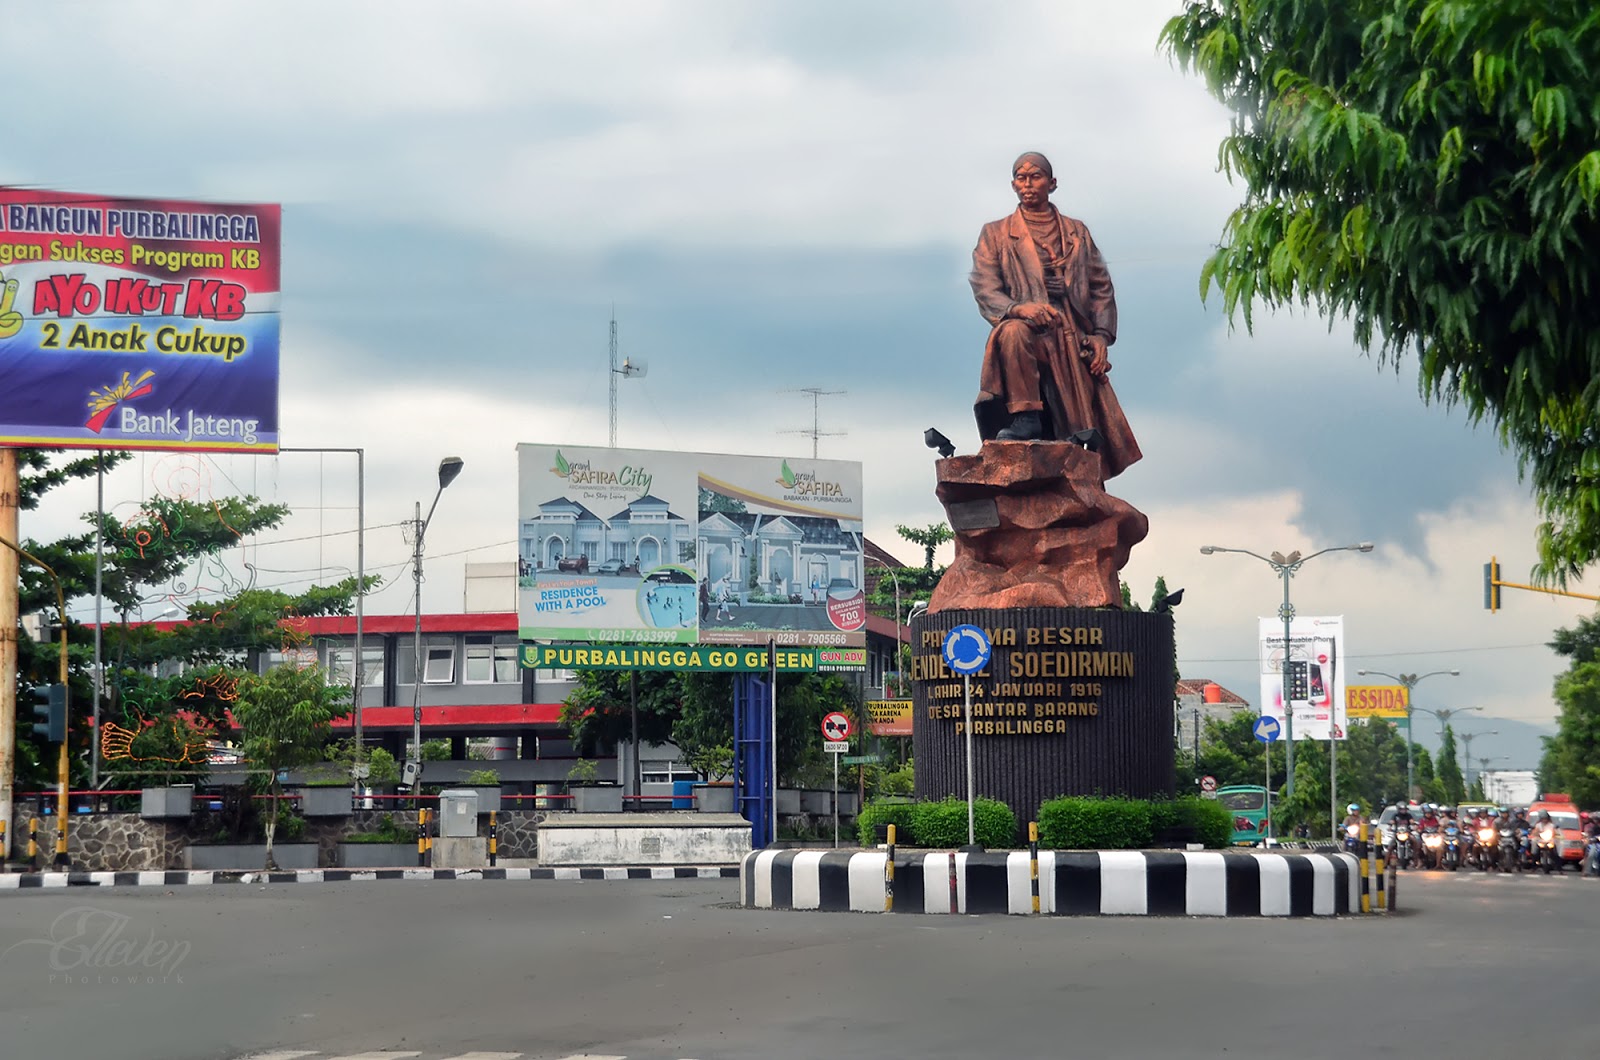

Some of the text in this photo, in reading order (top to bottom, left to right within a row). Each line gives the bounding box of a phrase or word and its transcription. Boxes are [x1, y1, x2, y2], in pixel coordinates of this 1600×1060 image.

[8, 204, 103, 236] BANGUN
[107, 211, 260, 242] PURBALINGGA
[50, 240, 124, 264] Sukses
[131, 244, 224, 271] Program
[231, 249, 260, 269] KB
[33, 273, 101, 317] AYO
[183, 279, 246, 320] KB
[41, 322, 246, 362] 2 Anak Cukup
[121, 407, 259, 444] Bank Jateng
[572, 465, 653, 498] SAFIRA City
[798, 481, 843, 496] SAFIRA
[540, 587, 598, 600] RESIDENCE
[535, 596, 607, 612] WITH A POOL
[840, 610, 858, 622] 700
[599, 630, 678, 642] 0281-7633999
[777, 633, 799, 643] 0281
[808, 633, 847, 644] 7905566
[922, 627, 1103, 648] PANMA BESAR
[544, 649, 814, 668] PURBALINGGA GO GREEN
[820, 651, 863, 662] GUN ADV
[909, 652, 1134, 681] JENDE SOEDIRMAN
[928, 682, 1102, 699] LAHIR 24 JANUARI 1916
[1346, 689, 1406, 709] ESSIDA
[929, 703, 960, 719] DESA
[1034, 702, 1098, 718] BARANG
[955, 720, 1066, 735] PURBALINGGA
